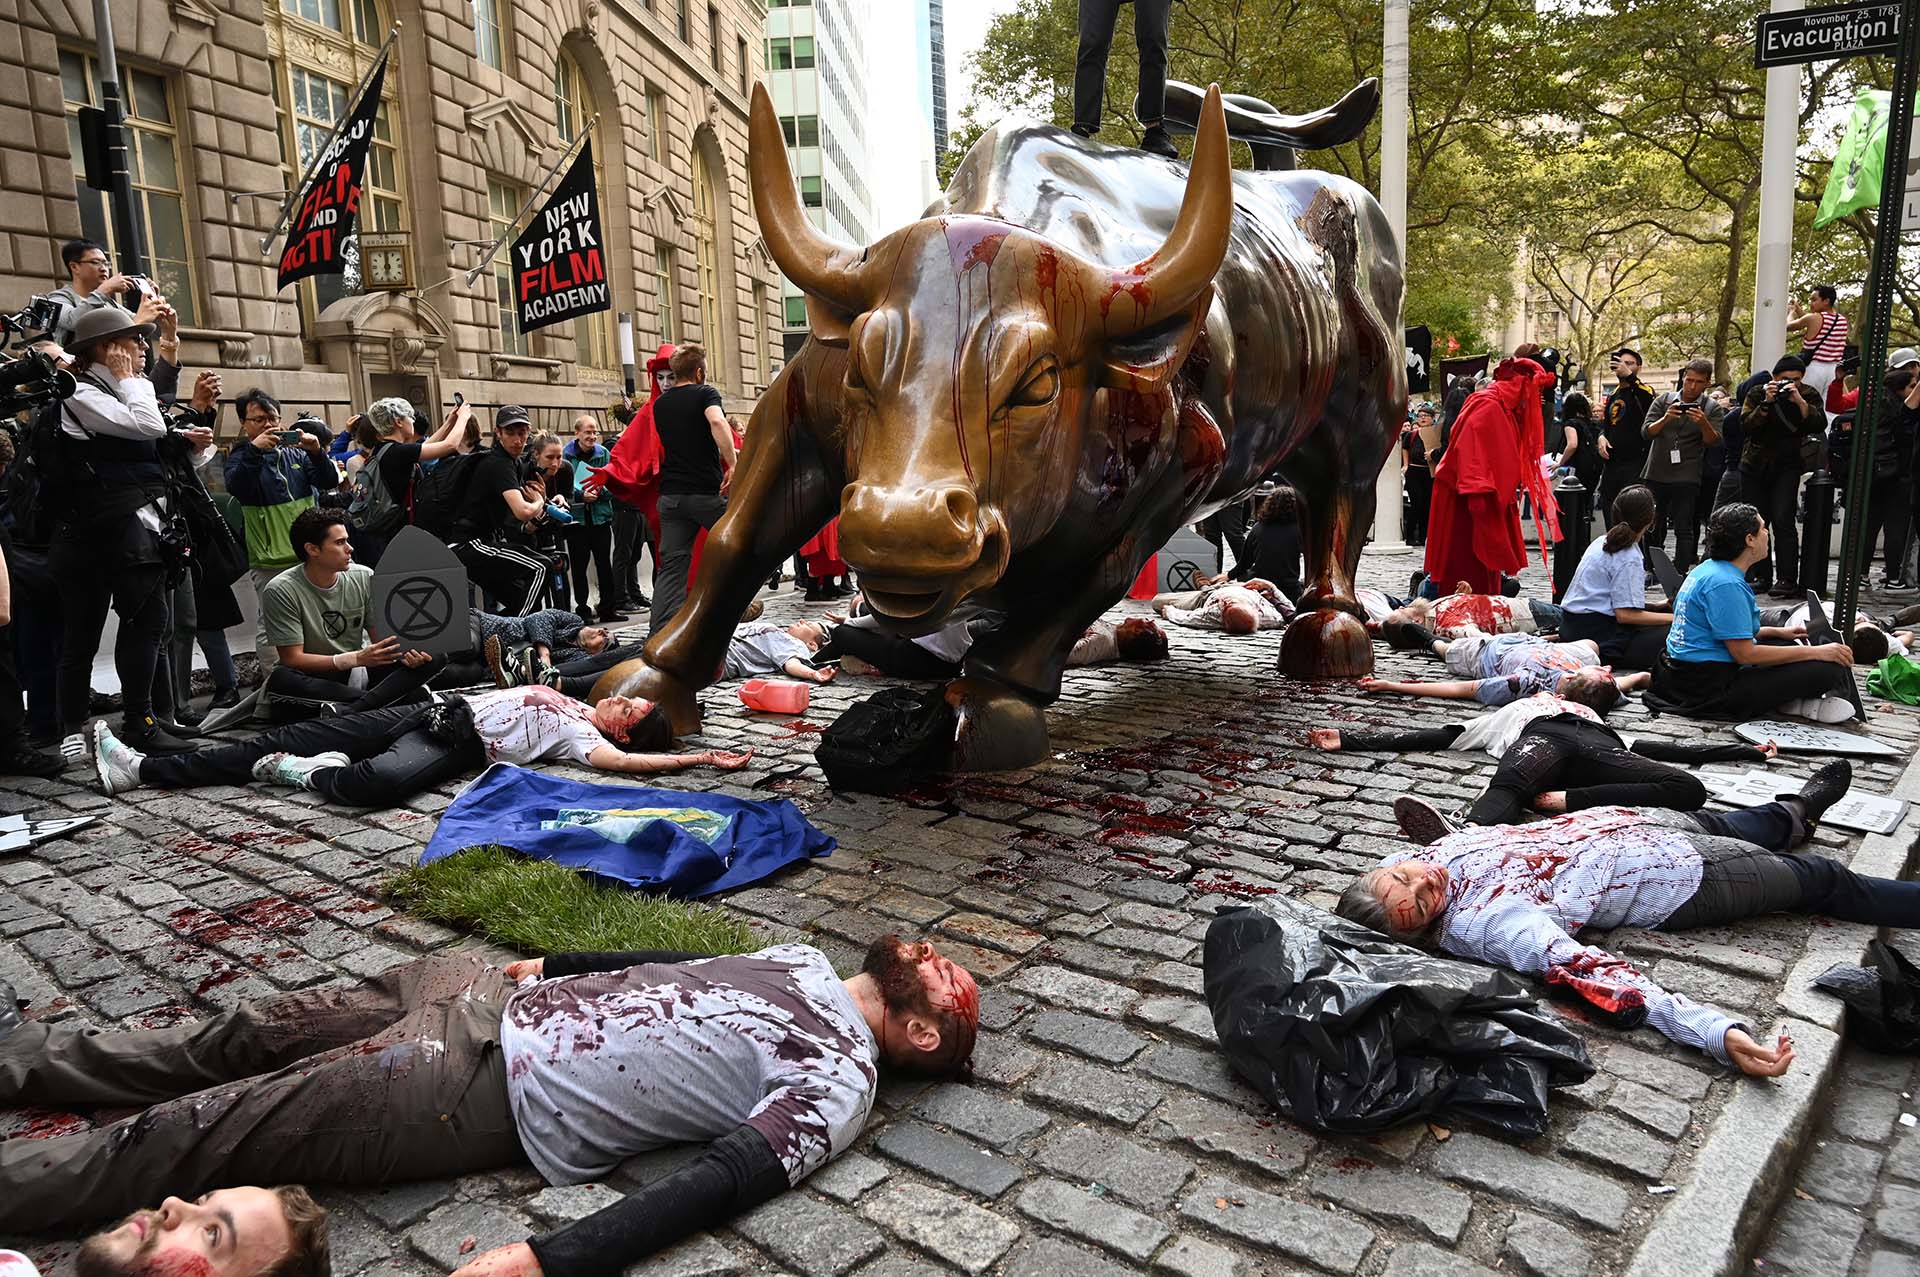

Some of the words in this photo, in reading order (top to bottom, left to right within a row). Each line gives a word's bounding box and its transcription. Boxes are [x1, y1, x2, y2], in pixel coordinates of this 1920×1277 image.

[1767, 19, 1887, 51] Evacuation
[1804, 14, 1850, 27] November
[1878, 6, 1900, 17] 1783
[1834, 39, 1864, 51] PLAZA
[545, 192, 589, 233] NEW
[519, 220, 597, 268] YORK
[520, 248, 604, 302] FILM
[524, 284, 605, 322] ACADEMY
